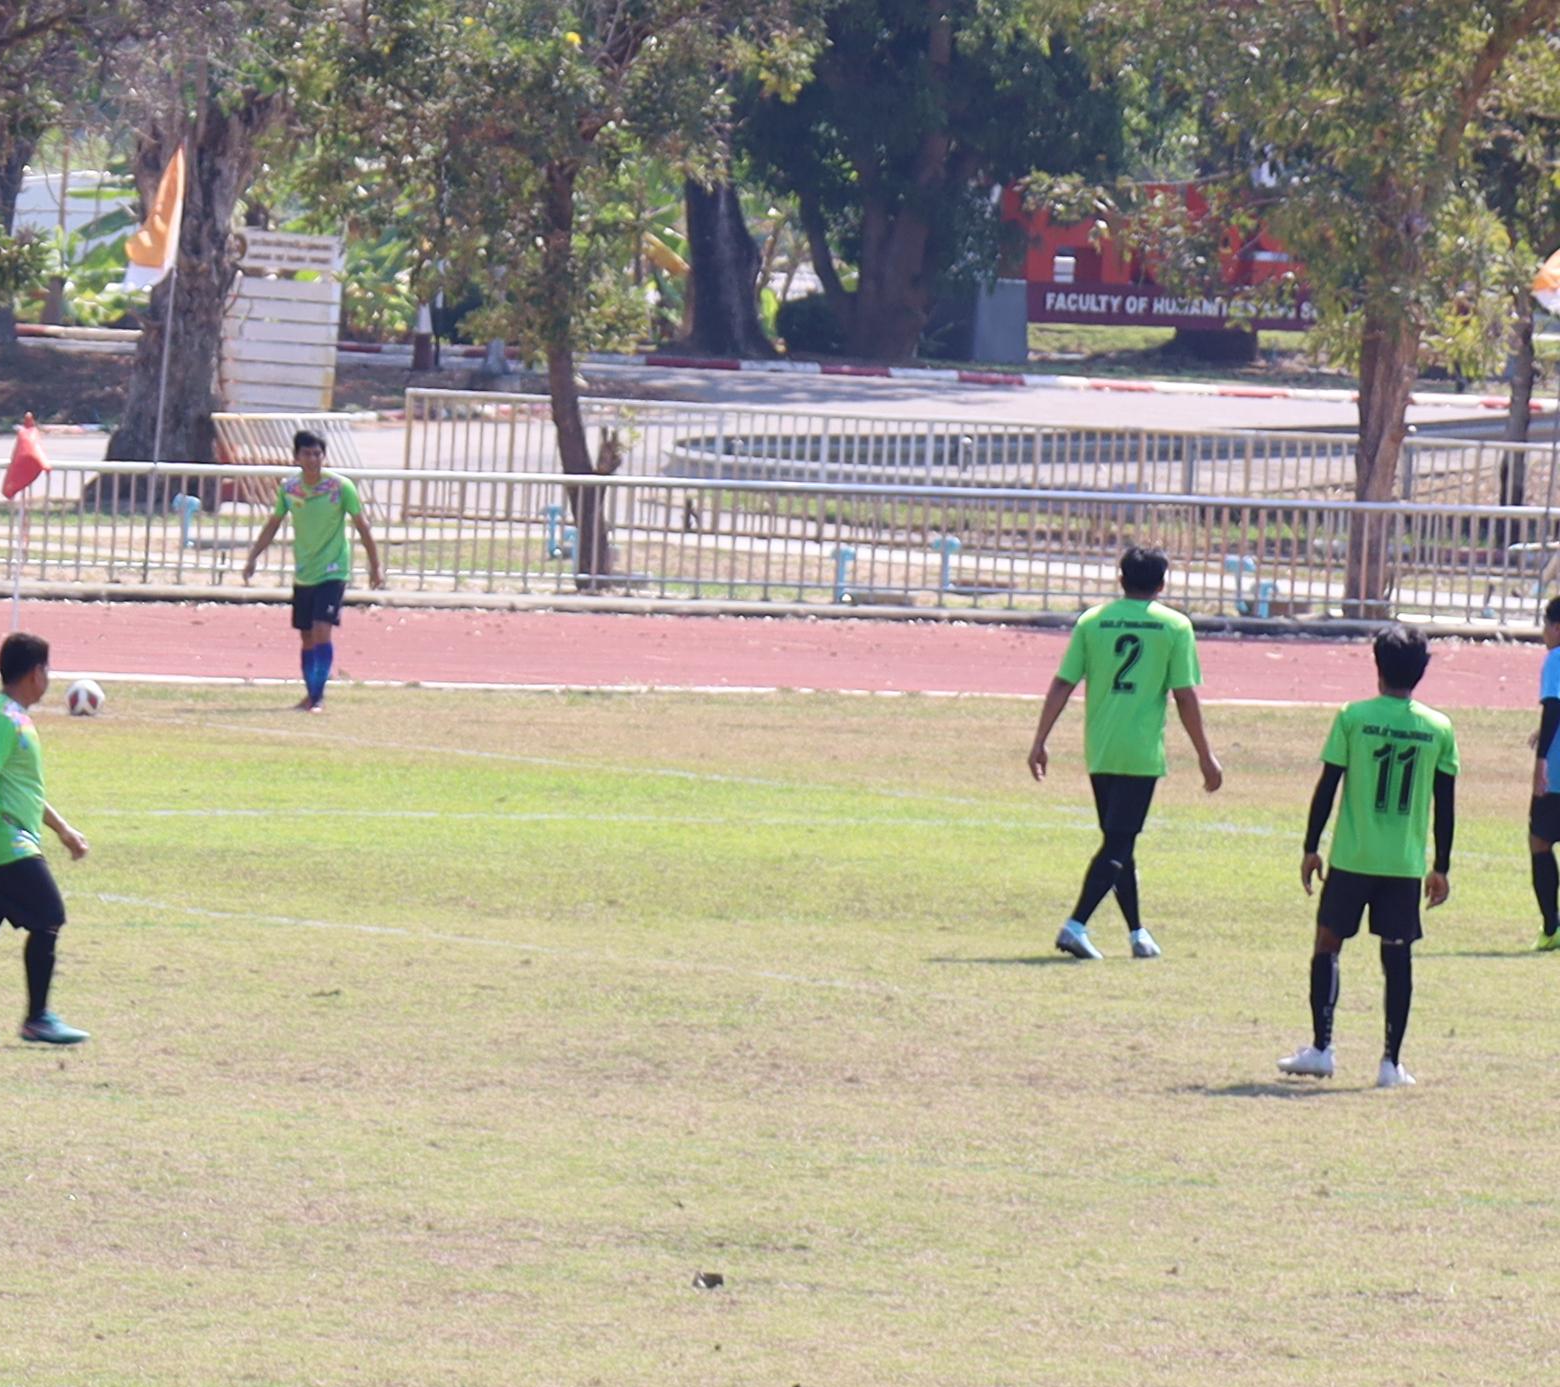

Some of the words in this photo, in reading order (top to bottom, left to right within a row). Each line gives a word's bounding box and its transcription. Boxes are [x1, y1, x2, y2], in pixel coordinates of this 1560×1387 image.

[1045, 292, 1121, 313] FACULTY
[1125, 296, 1148, 314] OF
[1112, 633, 1144, 694] 2
[1373, 743, 1418, 815] 11
